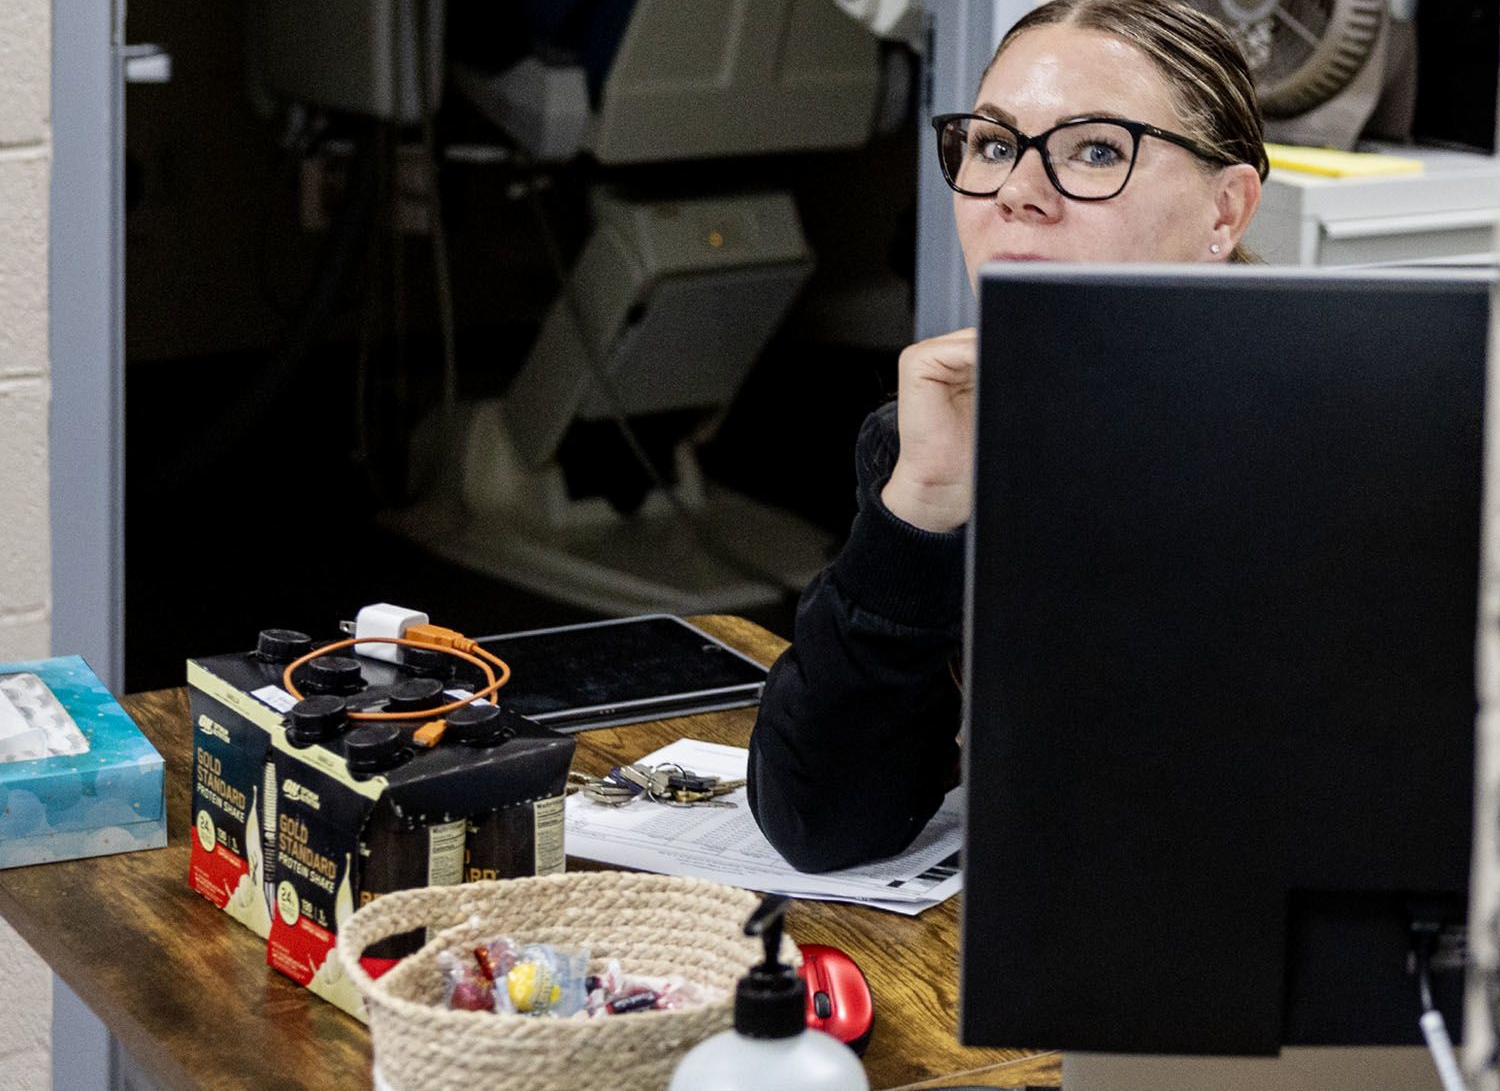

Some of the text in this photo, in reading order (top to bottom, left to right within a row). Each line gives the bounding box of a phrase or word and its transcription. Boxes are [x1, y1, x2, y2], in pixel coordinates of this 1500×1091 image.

[197, 747, 221, 777] GOLD
[197, 764, 246, 810] STANDARD
[197, 782, 245, 824] PROTEIN SHAKE
[279, 813, 308, 845] GOLD
[278, 851, 335, 894] PROTEIN SHAKE
[279, 831, 336, 880] STANDARD
